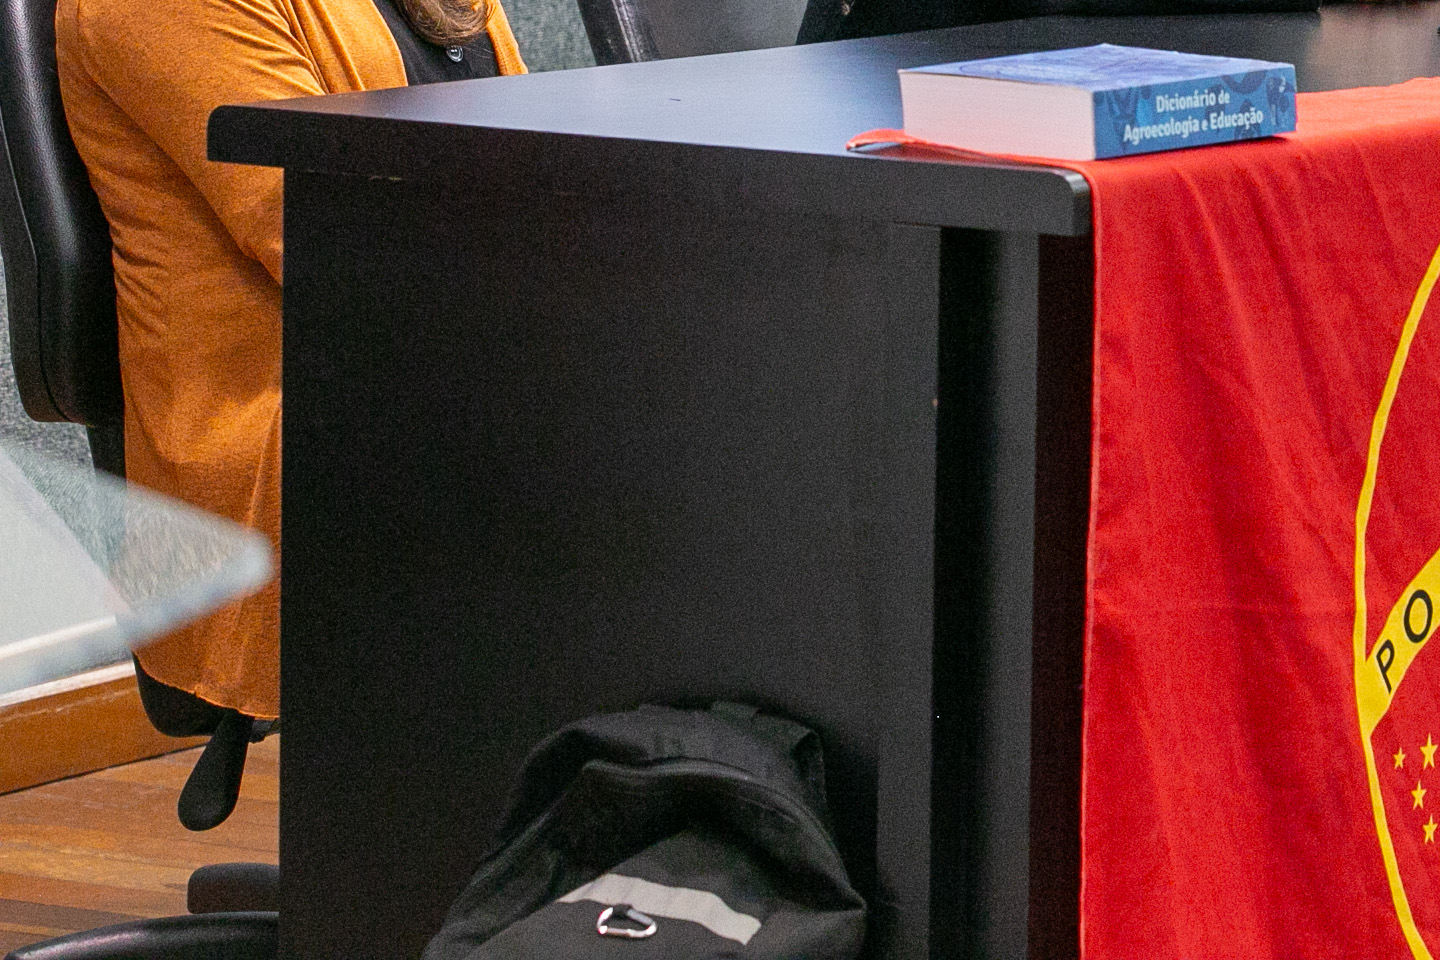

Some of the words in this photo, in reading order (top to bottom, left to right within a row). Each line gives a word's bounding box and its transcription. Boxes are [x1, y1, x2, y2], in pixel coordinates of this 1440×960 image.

[1155, 89, 1216, 113] Dicionário
[1217, 89, 1231, 105] de
[1123, 115, 1200, 146] Agroecologia
[1201, 119, 1209, 132] e
[1209, 106, 1264, 131] Educação
